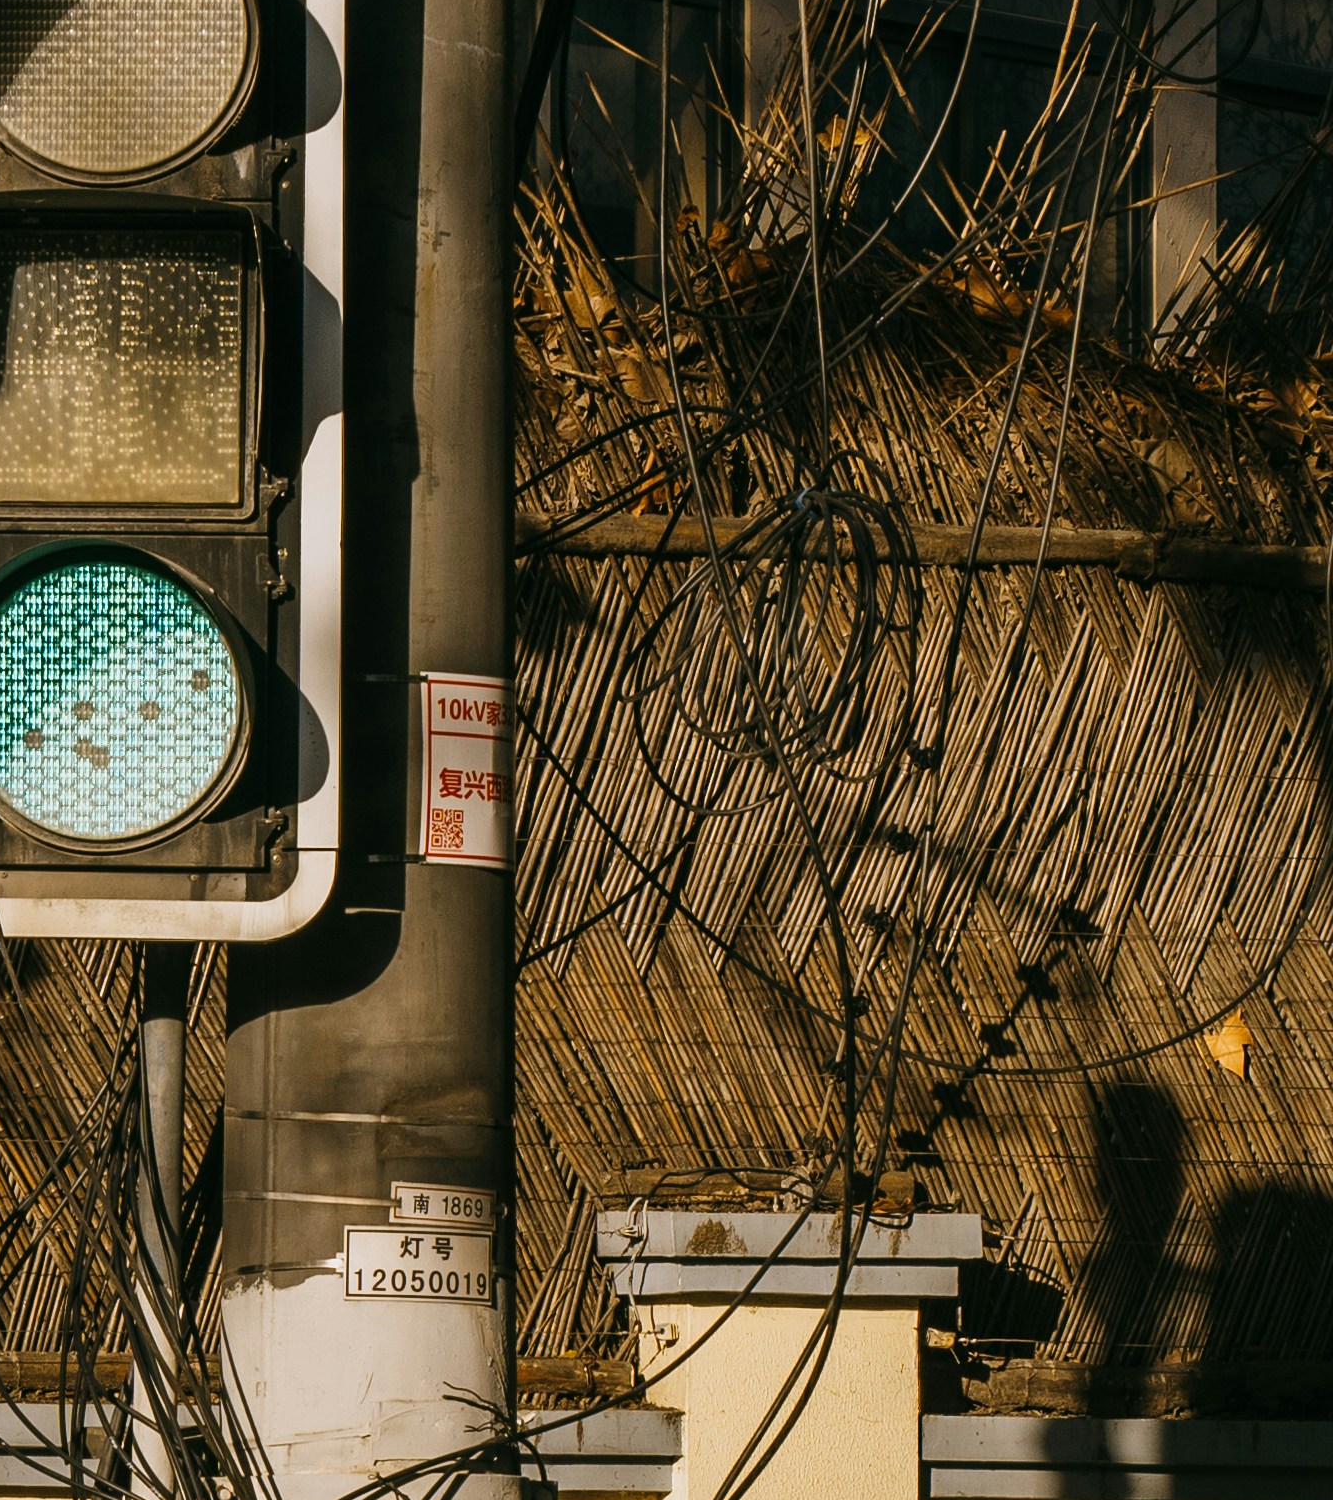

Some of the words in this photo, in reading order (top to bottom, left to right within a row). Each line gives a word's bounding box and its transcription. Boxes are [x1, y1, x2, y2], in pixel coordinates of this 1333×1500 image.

[413, 1193, 430, 1214] 南
[442, 1196, 483, 1218] 1869
[400, 1236, 454, 1260] 灯号
[354, 1268, 486, 1296] 12050019
